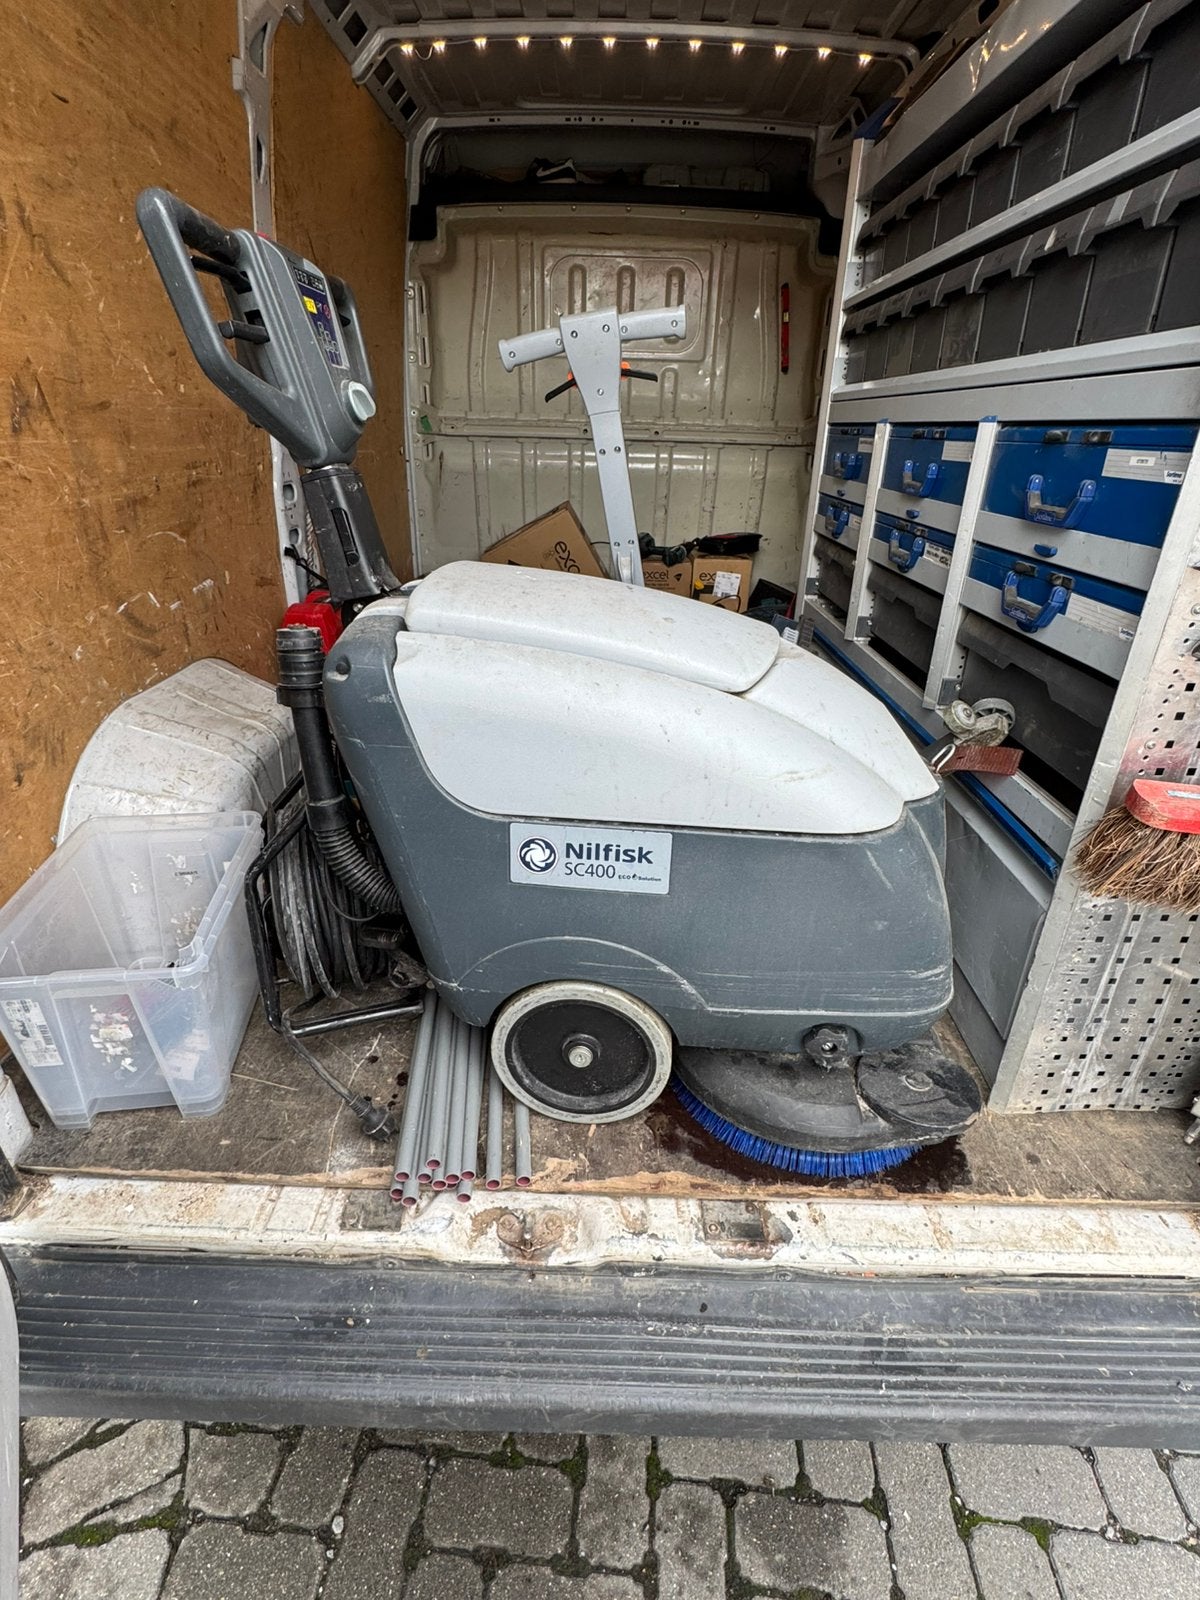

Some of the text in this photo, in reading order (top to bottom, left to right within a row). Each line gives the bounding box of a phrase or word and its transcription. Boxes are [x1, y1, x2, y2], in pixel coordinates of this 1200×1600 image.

[643, 570, 669, 580] xcel
[699, 572, 716, 581] ex
[565, 842, 654, 864] Nilfisk
[564, 861, 616, 879] SC400
